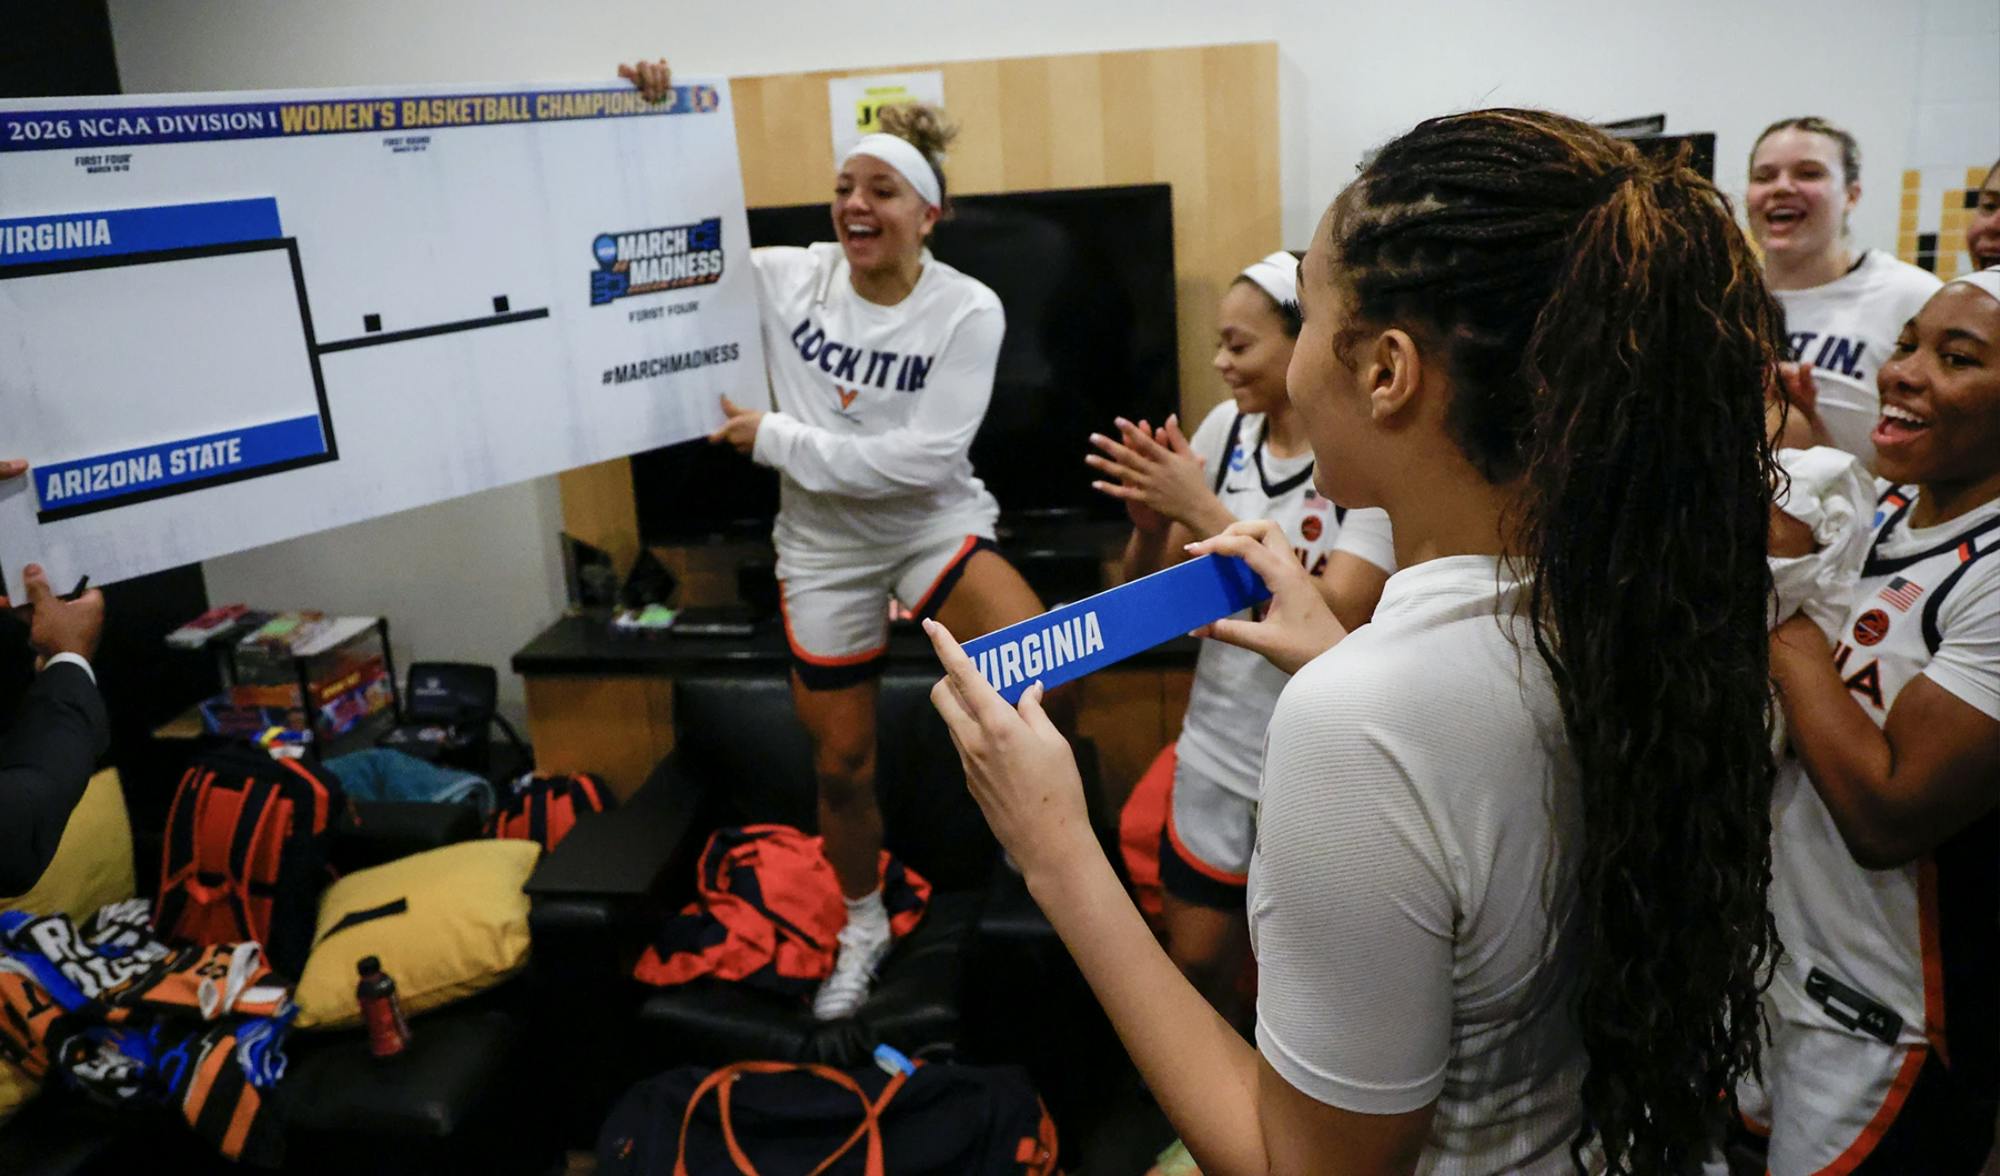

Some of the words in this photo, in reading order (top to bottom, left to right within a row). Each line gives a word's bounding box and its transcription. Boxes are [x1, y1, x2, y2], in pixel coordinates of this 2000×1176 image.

[8, 120, 72, 140] 2026
[79, 116, 152, 137] NCAA
[158, 111, 263, 134] DIVISION
[269, 111, 278, 128] I
[281, 102, 395, 132] WOMEN'S
[401, 95, 531, 127] BASKETBALL
[75, 155, 102, 166] FIRST
[617, 228, 687, 260] MARCH
[629, 250, 722, 285] MADNESS
[629, 306, 664, 322] FIRST
[668, 301, 699, 315] FOUR
[602, 342, 740, 385] #MARCHMADNESS
[792, 317, 862, 382] LOCK
[862, 351, 898, 388] IT
[1815, 335, 1866, 380] IN.
[46, 454, 163, 501] ARIZONA
[170, 437, 242, 476] STATE
